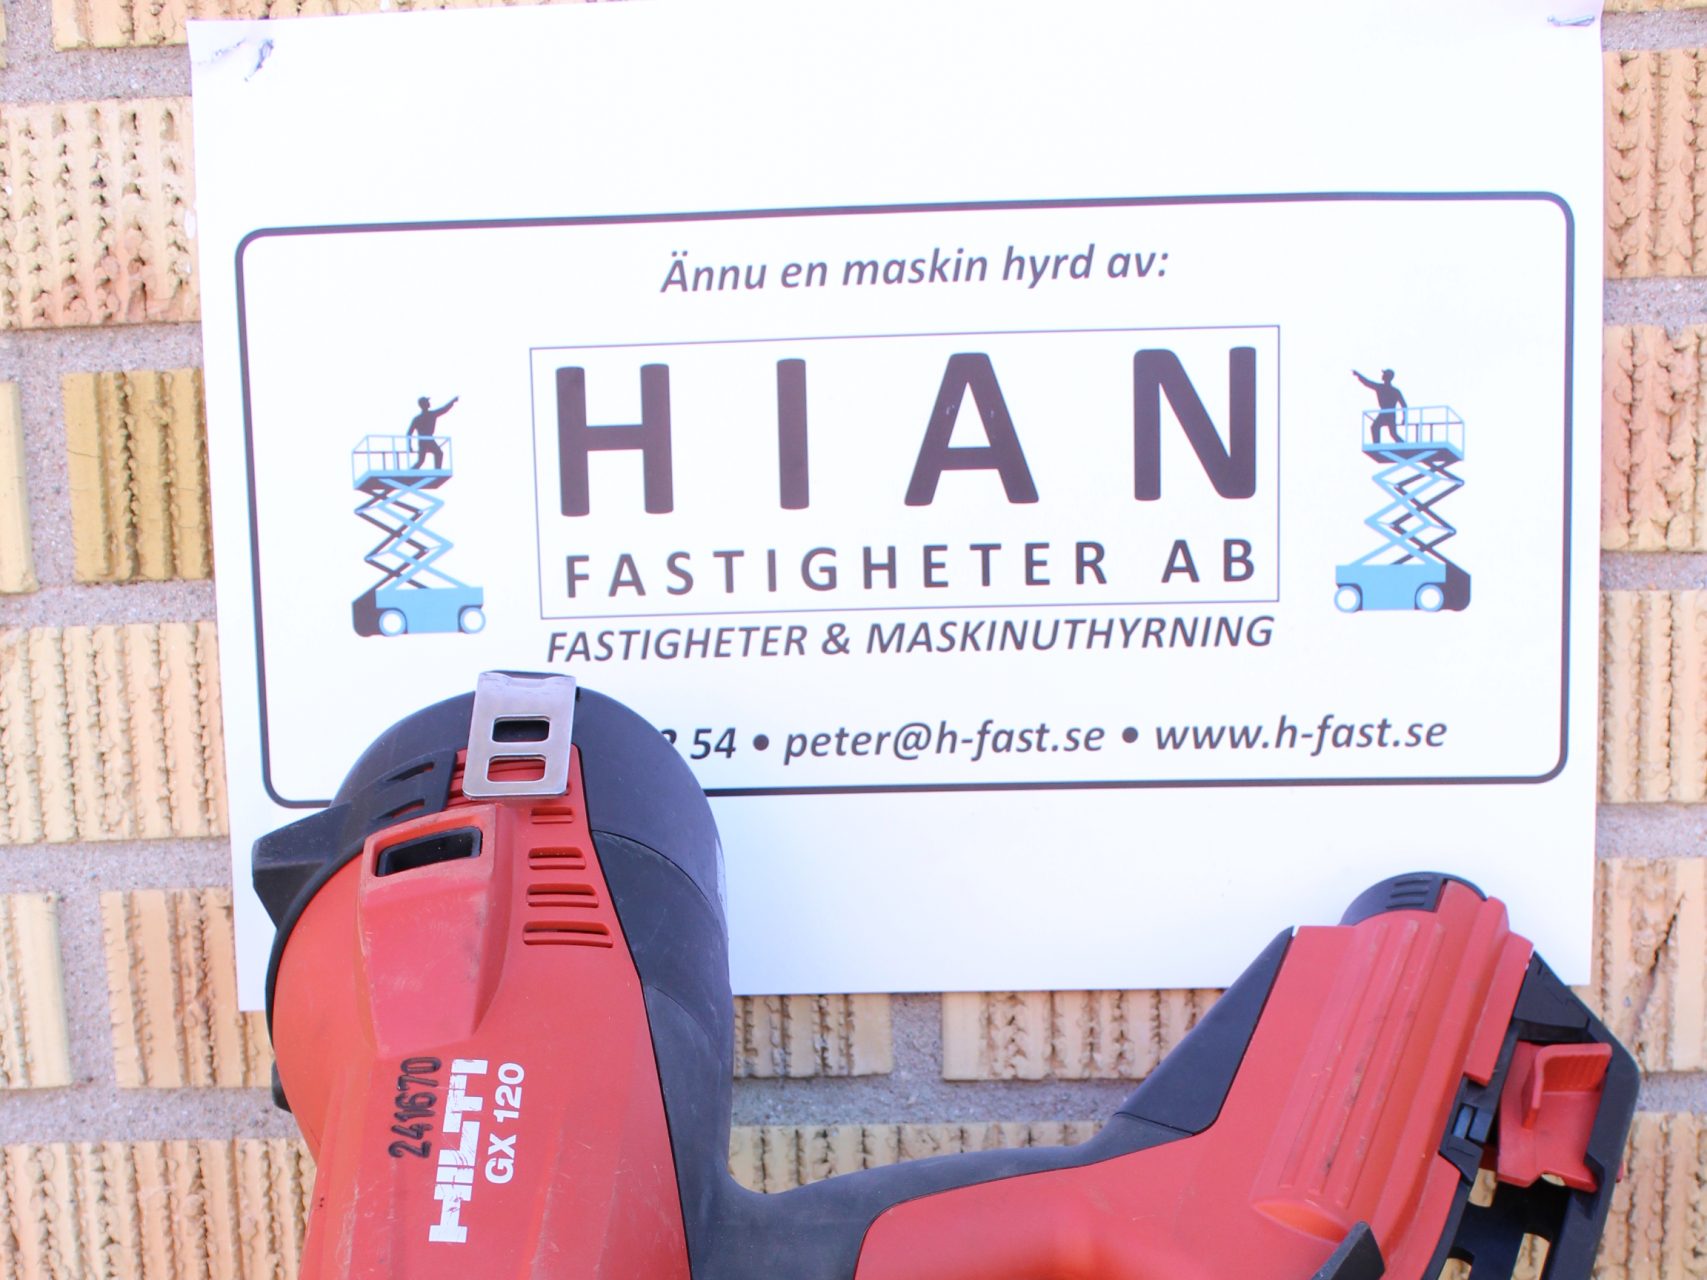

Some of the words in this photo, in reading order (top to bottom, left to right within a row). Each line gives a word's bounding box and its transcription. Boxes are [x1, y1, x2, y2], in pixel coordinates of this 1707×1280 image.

[660, 249, 767, 293] Ännu
[781, 262, 828, 288] en
[842, 248, 988, 286] maskin
[1002, 243, 1096, 289] hyrd
[1107, 249, 1170, 279] av:
[555, 346, 1257, 517] HIAN
[566, 541, 1108, 598] FASTIGHETER
[1161, 538, 1256, 584] AB
[547, 625, 808, 663] FASTIGHETER
[821, 623, 850, 655] &
[866, 615, 1275, 654] MASKINUTHYRNING
[689, 727, 738, 761] 54
[783, 719, 1106, 767] peter@h-fast.se
[1155, 713, 1448, 758] www.h-fast.se
[387, 1056, 442, 1160] 241670
[493, 1062, 526, 1124] 120
[428, 1058, 489, 1244] HILTI
[484, 1132, 518, 1185] GX
